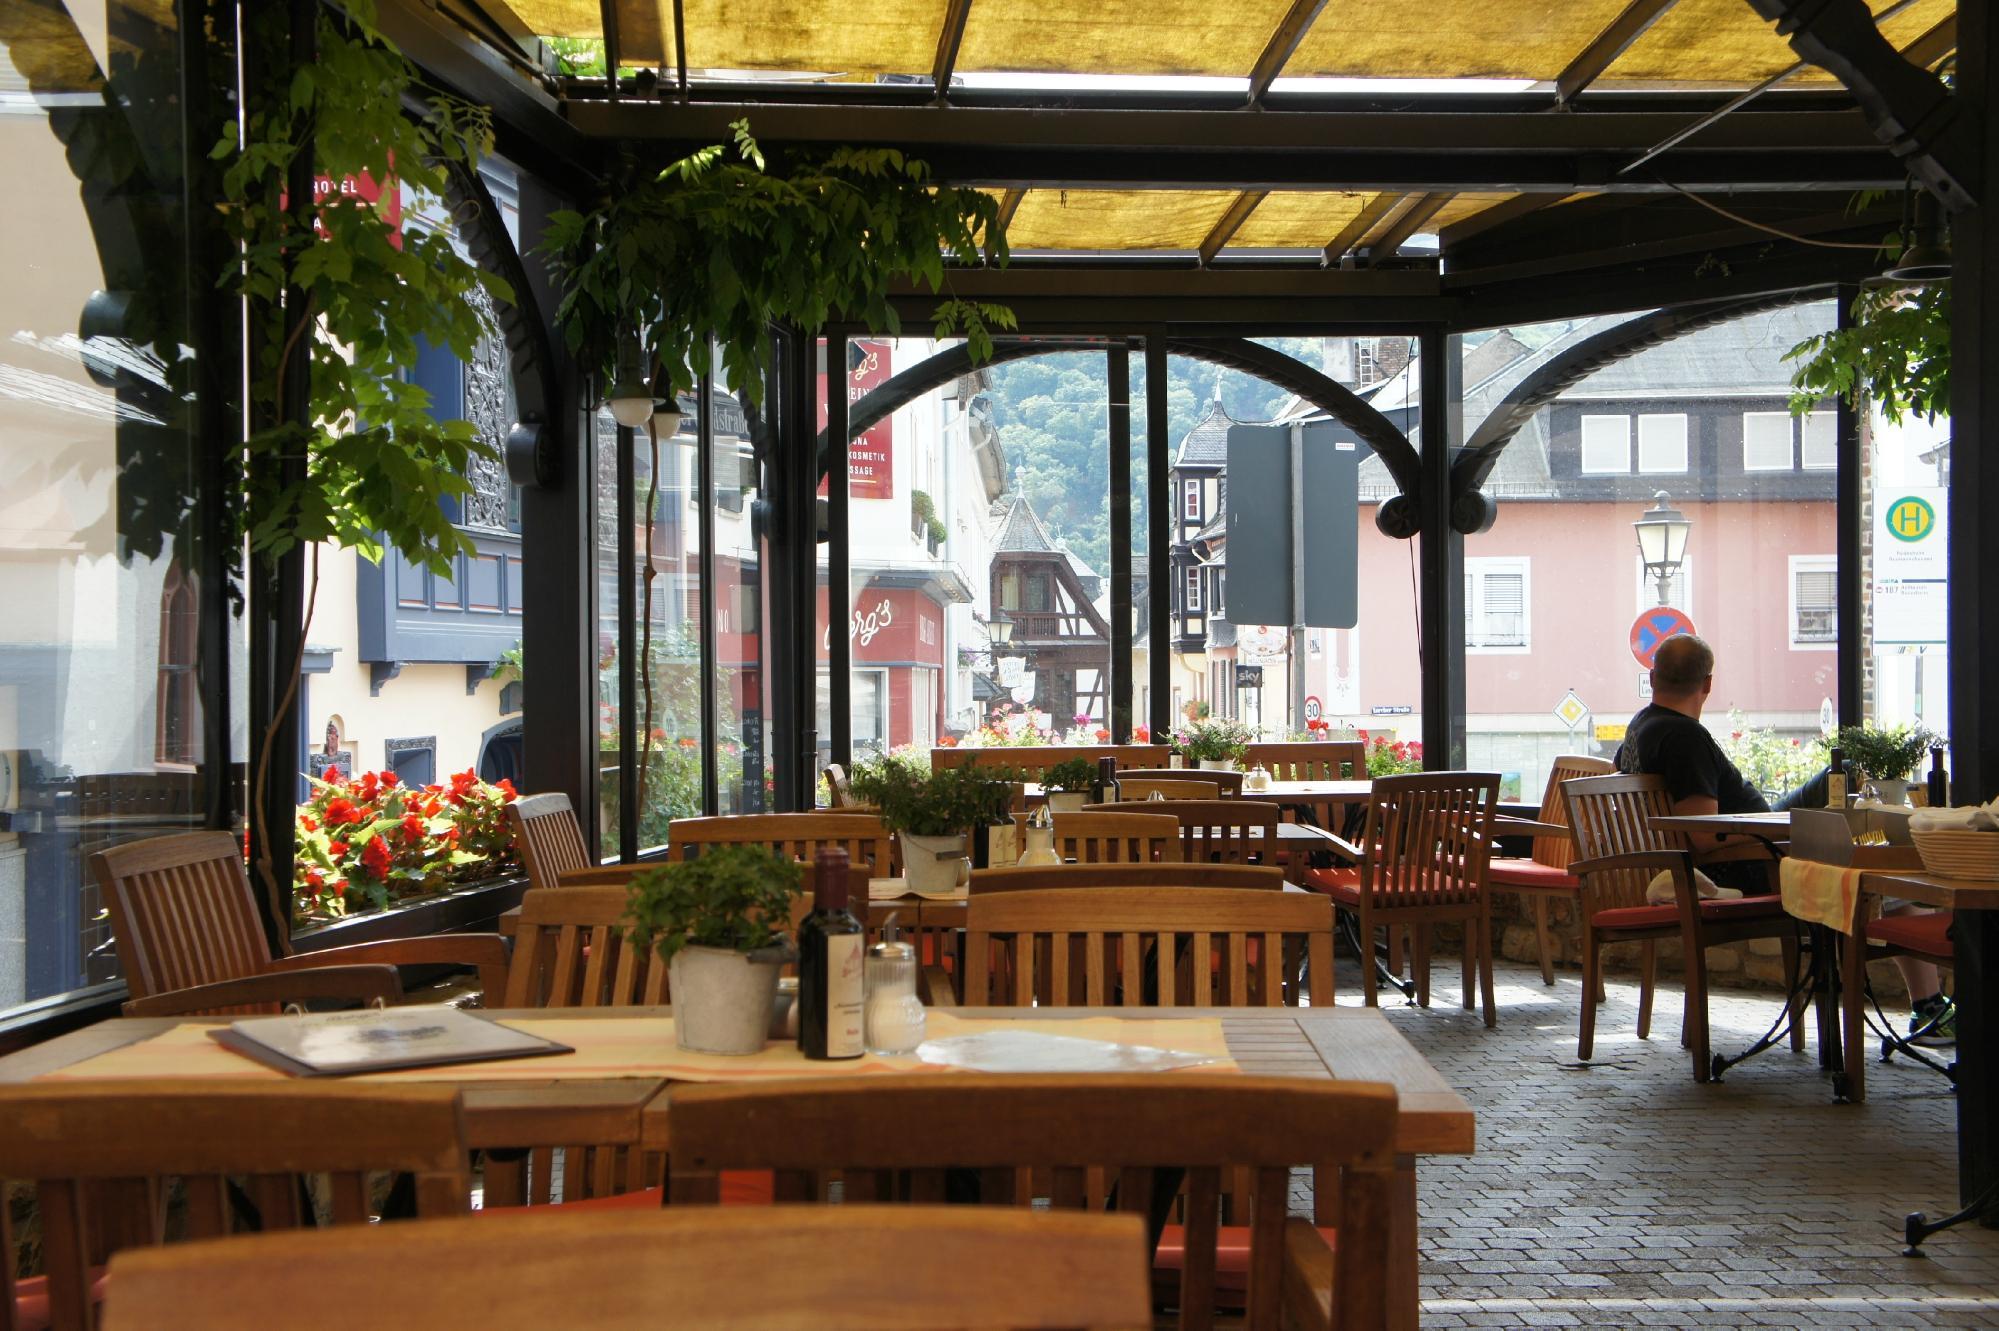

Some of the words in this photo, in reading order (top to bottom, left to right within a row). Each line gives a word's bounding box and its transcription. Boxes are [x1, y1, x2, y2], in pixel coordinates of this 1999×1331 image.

[849, 465, 873, 476] SSAGE
[1238, 669, 1261, 683] sky
[1306, 703, 1319, 718] 30
